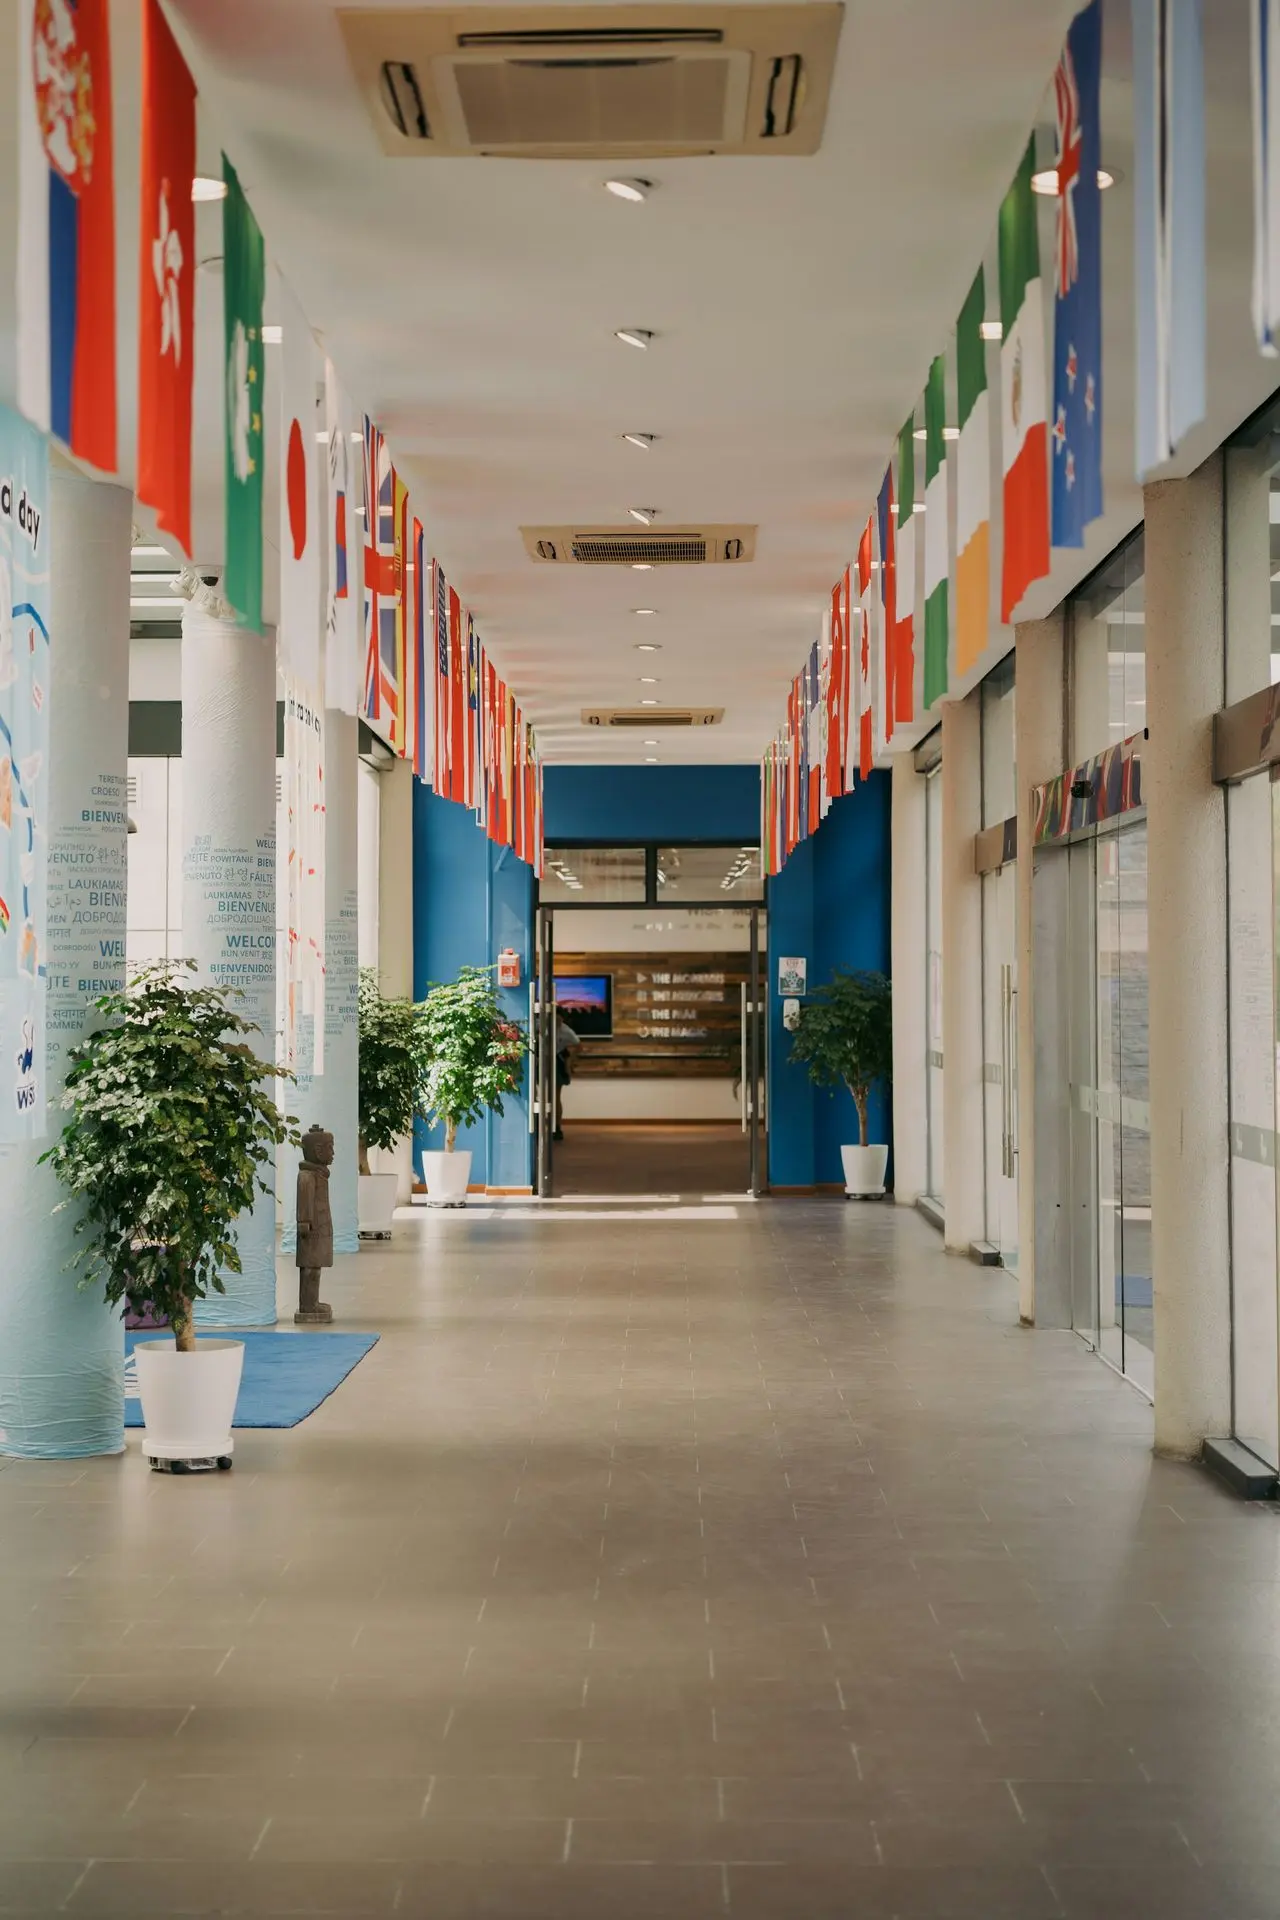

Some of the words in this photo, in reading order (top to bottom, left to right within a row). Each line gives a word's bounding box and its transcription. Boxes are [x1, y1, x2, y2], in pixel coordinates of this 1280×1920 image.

[19, 491, 40, 550] day
[68, 879, 124, 890] LAUKIAMAS
[204, 891, 252, 900] LAUKIAMAS
[221, 949, 238, 958] BUN
[240, 950, 260, 958] VENIT
[210, 963, 273, 974] BIENVENIDOS
[214, 973, 252, 987] VÍTEJTE
